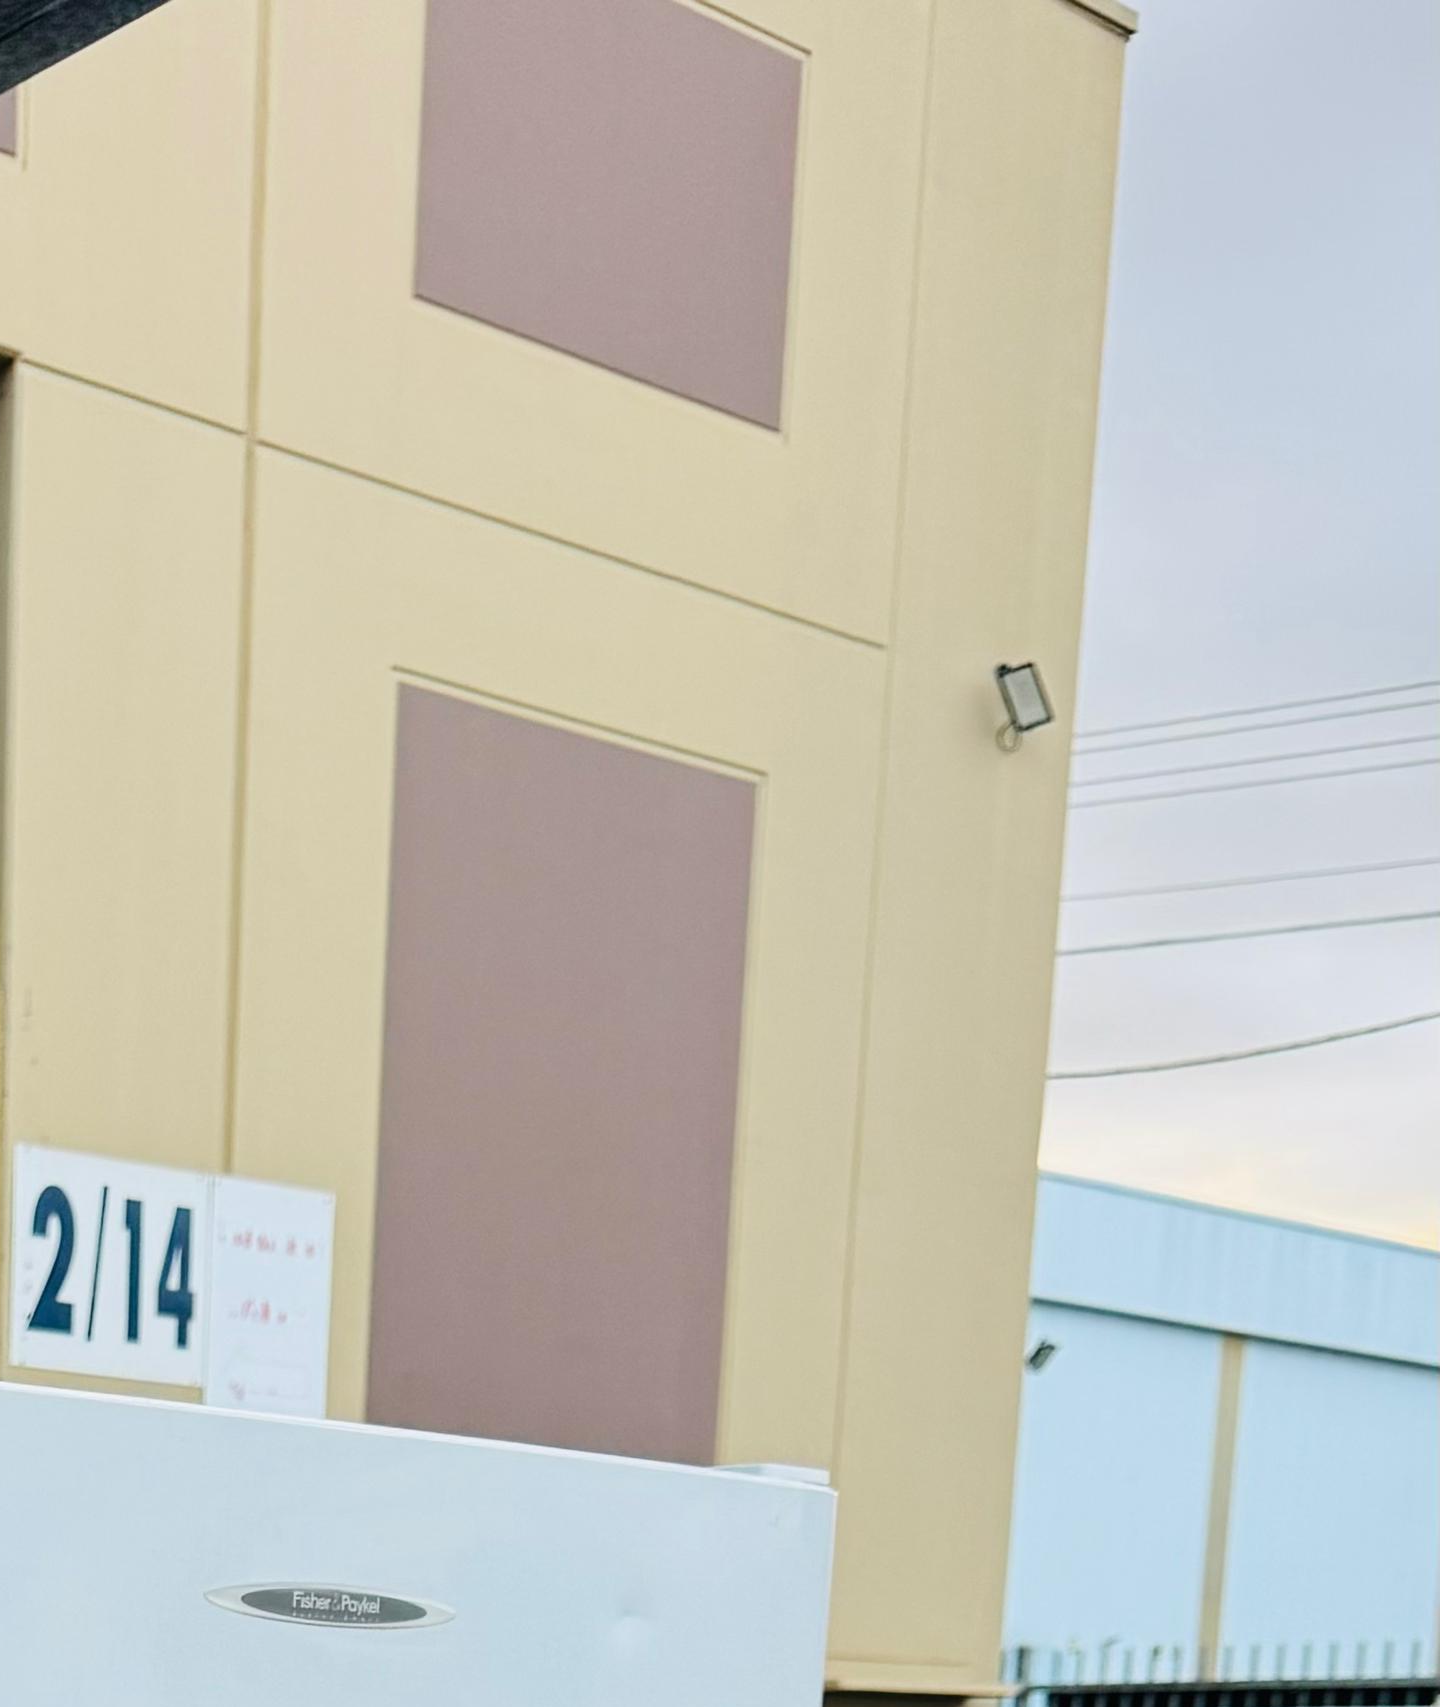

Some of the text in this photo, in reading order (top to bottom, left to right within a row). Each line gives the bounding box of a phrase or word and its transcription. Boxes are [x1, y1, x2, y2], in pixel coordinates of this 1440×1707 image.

[27, 1185, 194, 1349] 2/14
[293, 1591, 331, 1611] Fisher
[341, 1594, 380, 1616] Paykel
